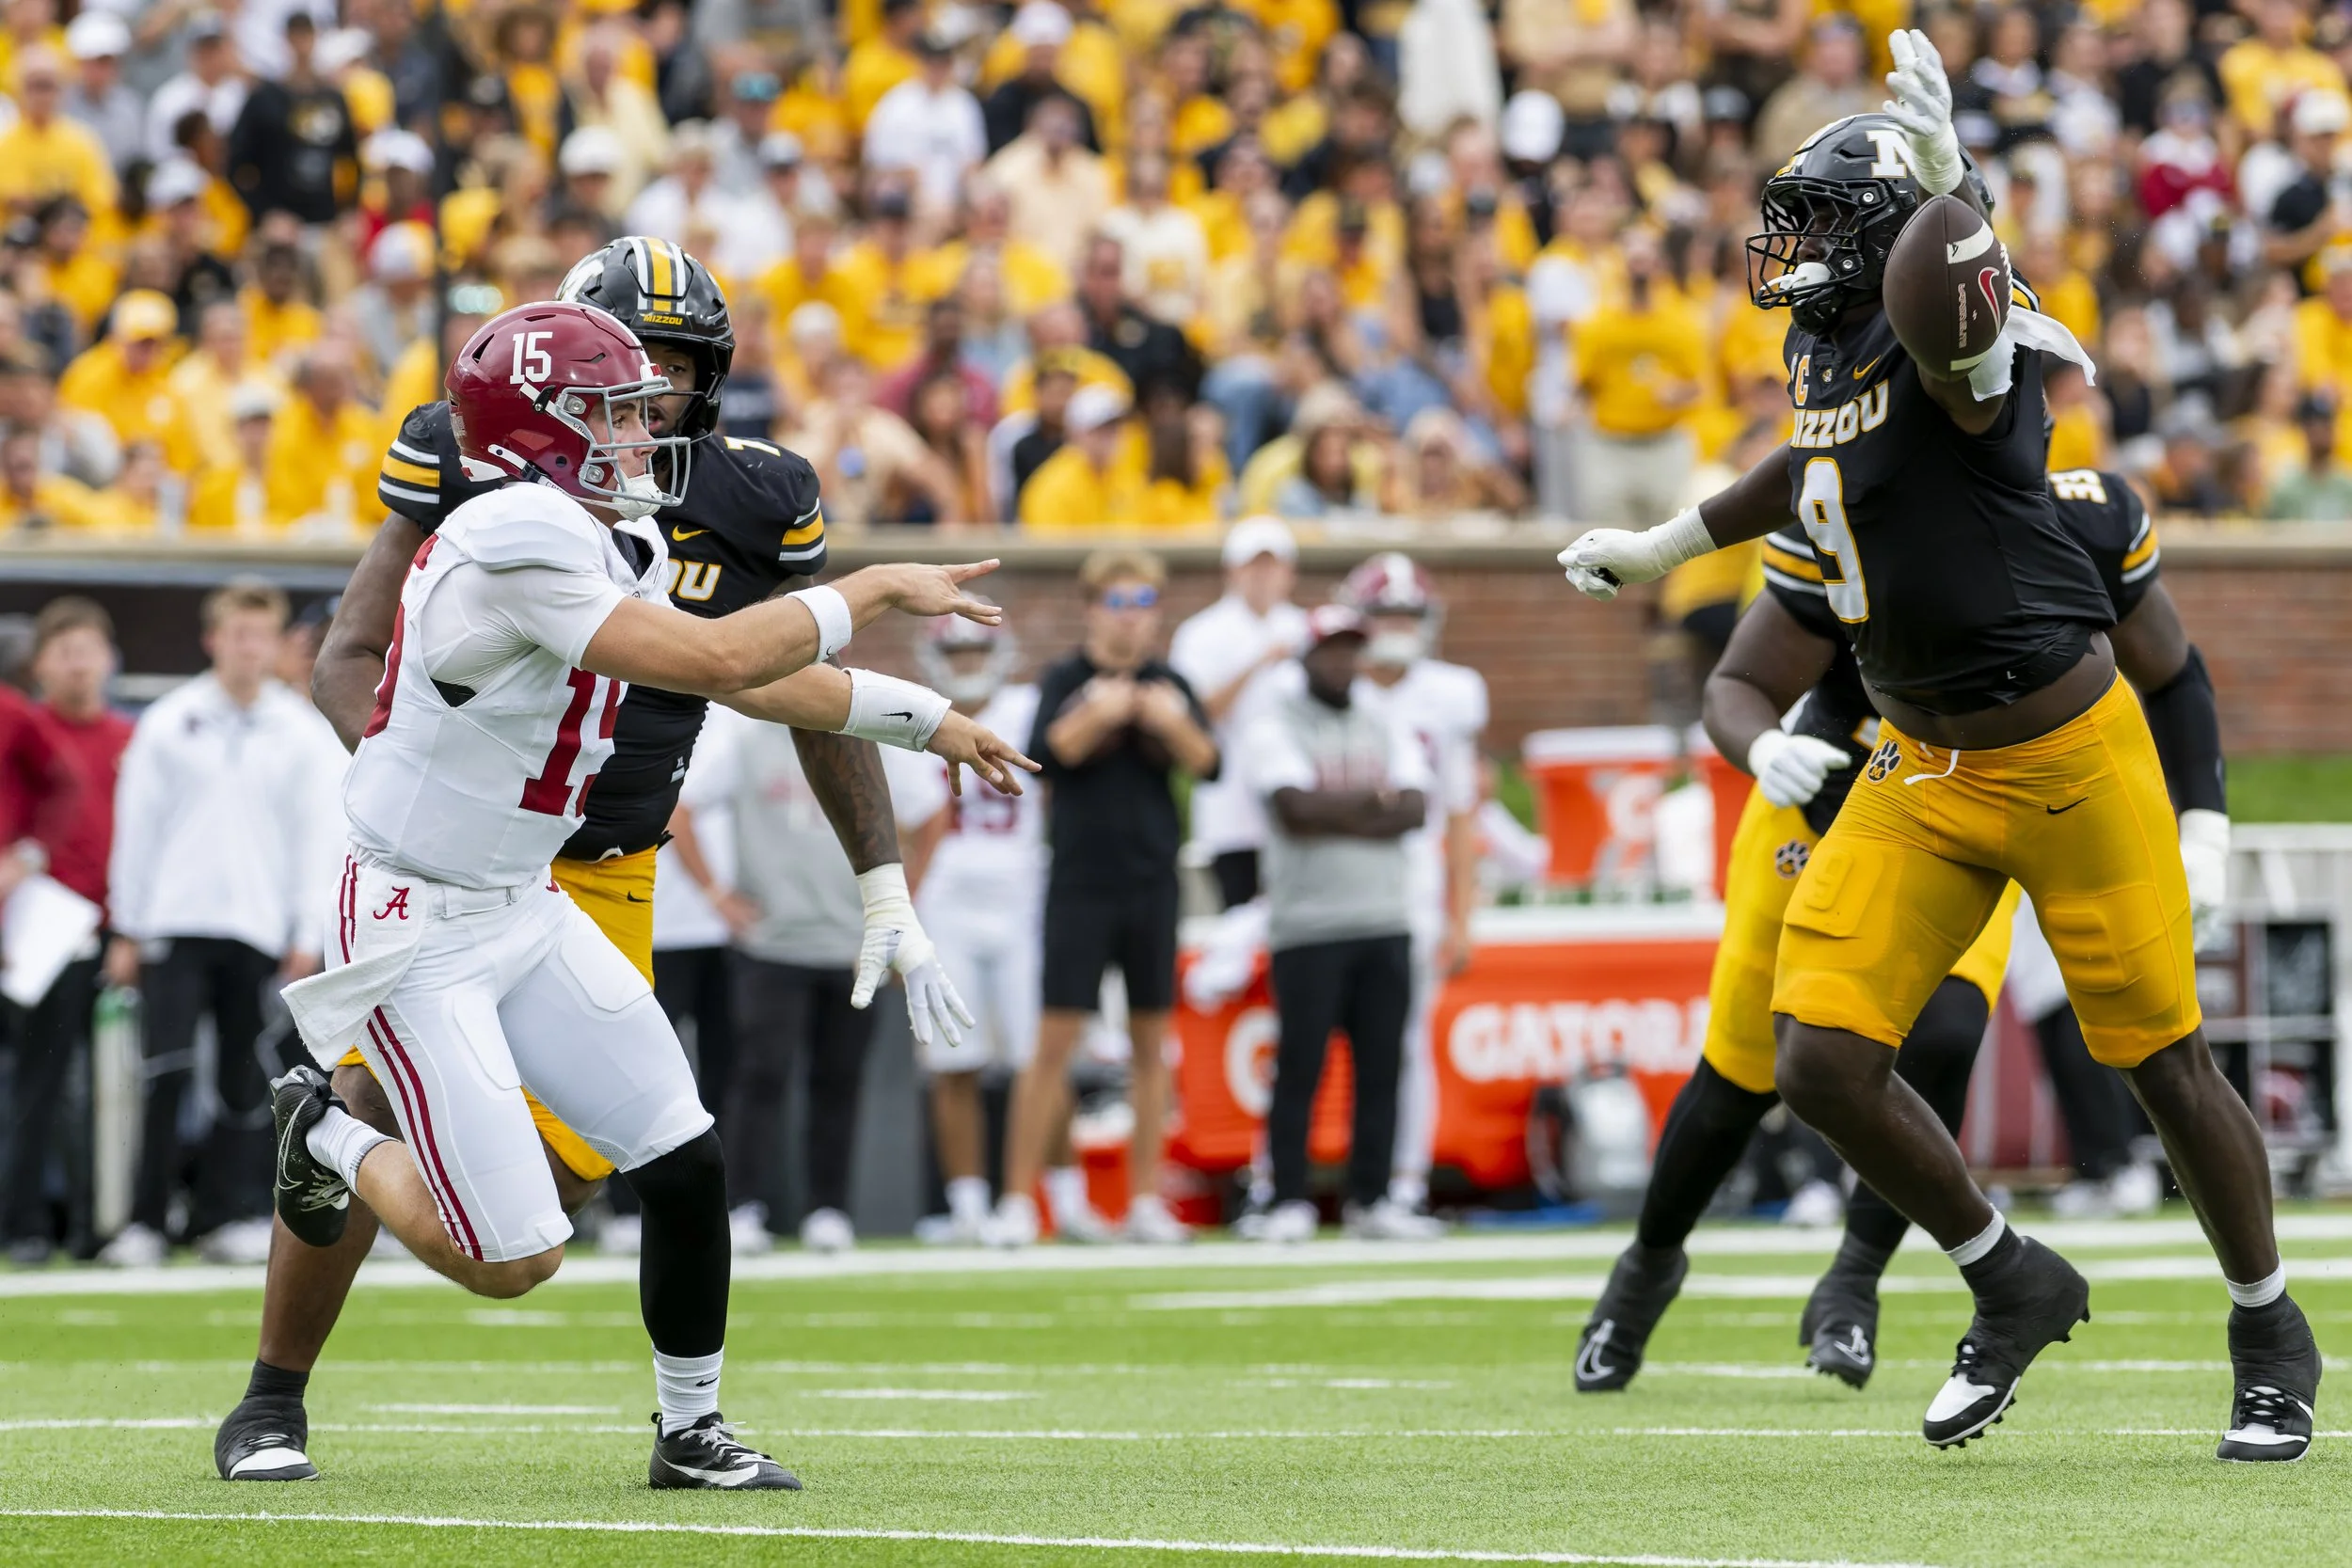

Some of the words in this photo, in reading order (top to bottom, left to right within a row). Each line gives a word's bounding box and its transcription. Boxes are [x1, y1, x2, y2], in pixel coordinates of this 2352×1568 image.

[643, 315, 683, 325] MIZZOU
[510, 331, 553, 385] 15
[1790, 378, 1889, 449] IZZOU
[1798, 456, 1869, 624] 9
[373, 886, 410, 920] A
